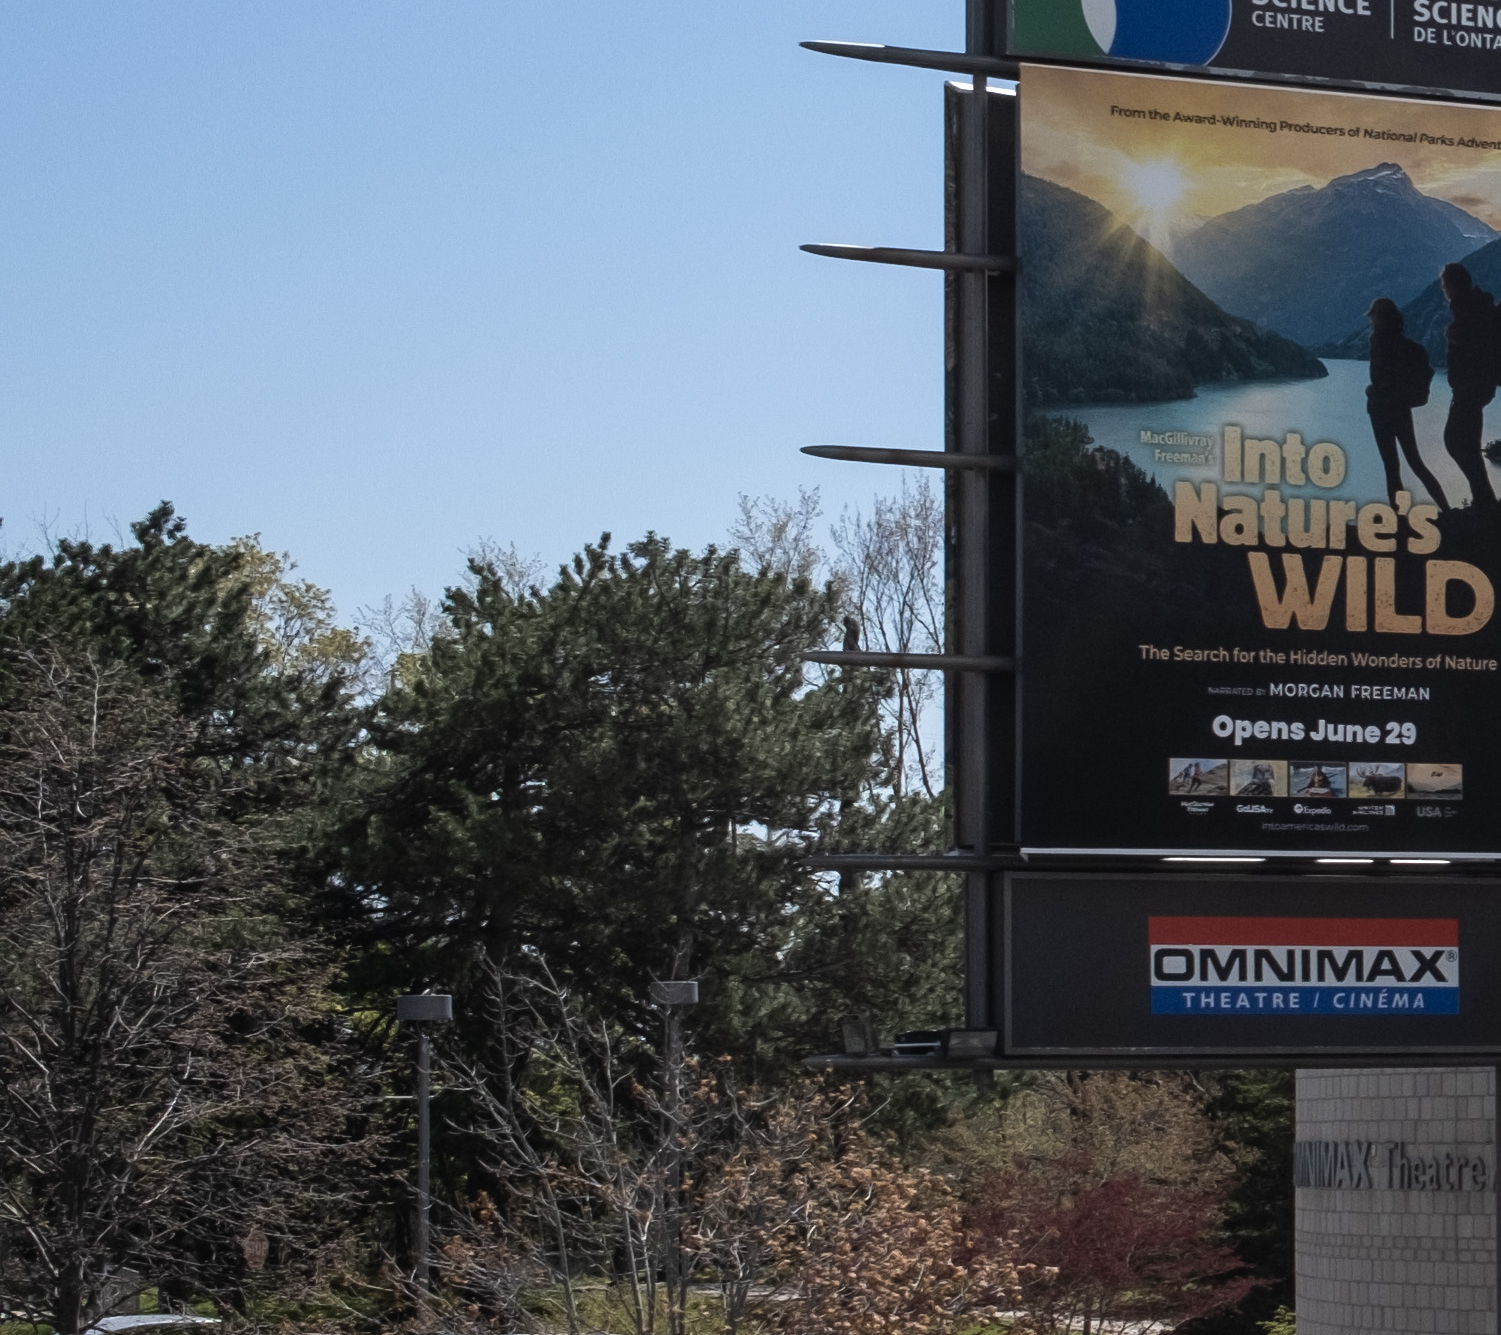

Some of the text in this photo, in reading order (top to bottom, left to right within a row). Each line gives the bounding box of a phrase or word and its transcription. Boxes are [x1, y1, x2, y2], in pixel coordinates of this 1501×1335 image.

[1251, 10, 1325, 33] CENTRE
[1413, 26, 1437, 45] DE
[1110, 105, 1147, 120] From
[1148, 108, 1171, 122] the
[1172, 111, 1278, 133] Award-Winning
[1279, 120, 1346, 137] Producers
[1347, 125, 1361, 139] of
[1363, 127, 1417, 144] National
[1419, 131, 1455, 147] Parks
[1139, 429, 1214, 451] MacGillivray
[1154, 449, 1215, 466] Freeman's
[1223, 425, 1347, 489] Into
[1174, 481, 1442, 555] Nature's
[1247, 551, 1495, 636] WILD
[1139, 644, 1499, 672] The Search for the Hidden Wonders of Nature
[1269, 681, 1345, 699] MORGAN
[1350, 684, 1431, 701] FREEMAN
[1211, 713, 1418, 747] Opens June 29
[1182, 988, 1426, 1009] THEATRE / CINÉMA
[1384, 1140, 1488, 1191] Theatre
